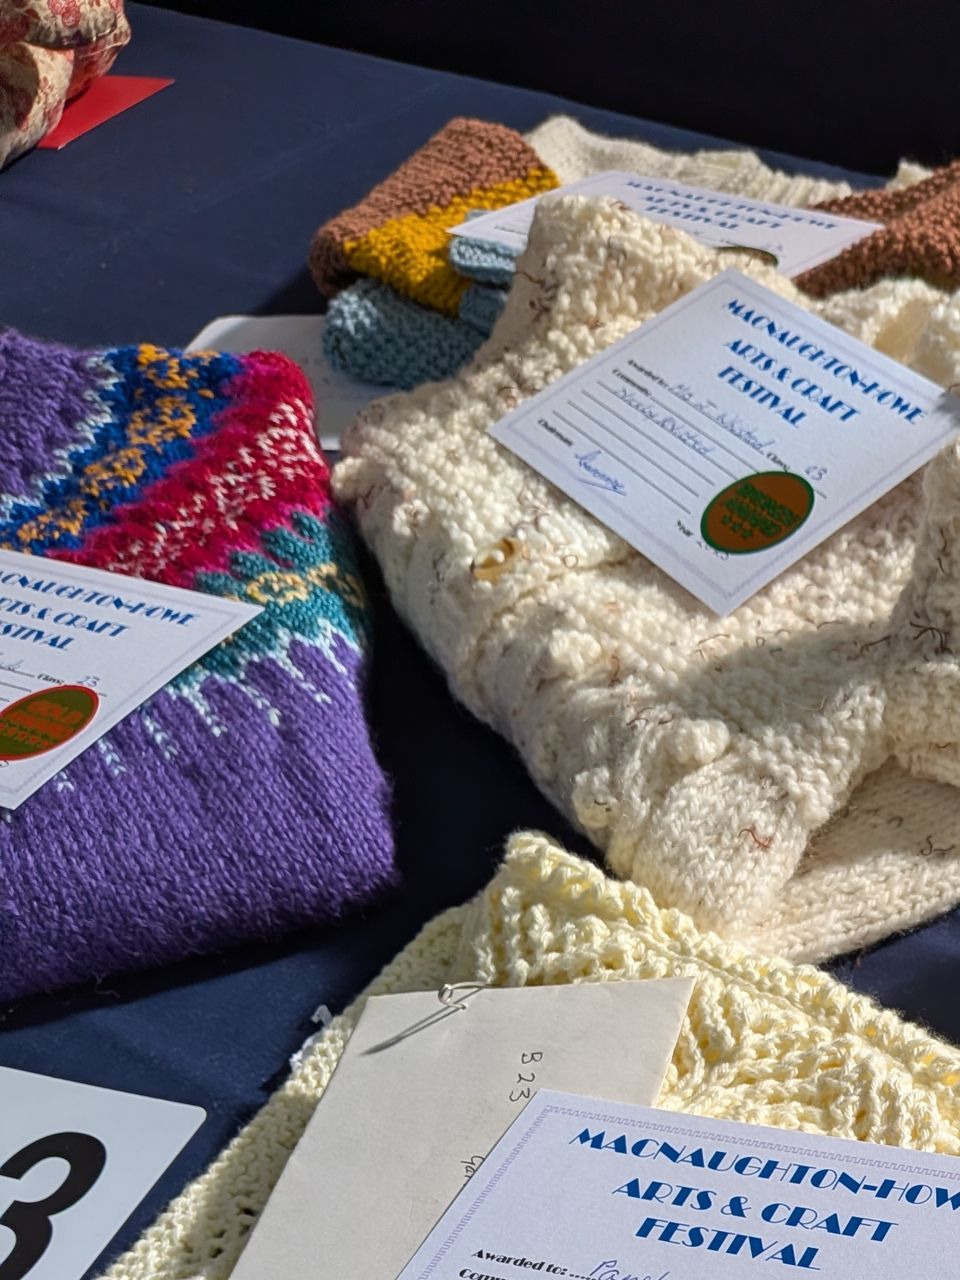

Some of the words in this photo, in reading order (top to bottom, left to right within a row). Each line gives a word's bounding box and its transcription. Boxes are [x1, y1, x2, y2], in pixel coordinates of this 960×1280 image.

[723, 299, 928, 425] MACNAUGHTON-HOWE
[724, 339, 777, 371] ARTS
[773, 366, 792, 382] &
[791, 378, 860, 422] CRAFT
[717, 366, 807, 429] FESTIVAL
[32, 608, 52, 620] &
[53, 612, 131, 638] CRAFT
[611, 1177, 719, 1211] ARTS
[720, 1195, 753, 1218] &
[760, 1203, 899, 1243] CRAFT
[471, 1249, 545, 1272] Awarded
[547, 1263, 569, 1276] to:
[634, 1216, 822, 1271] FESTIVAL
